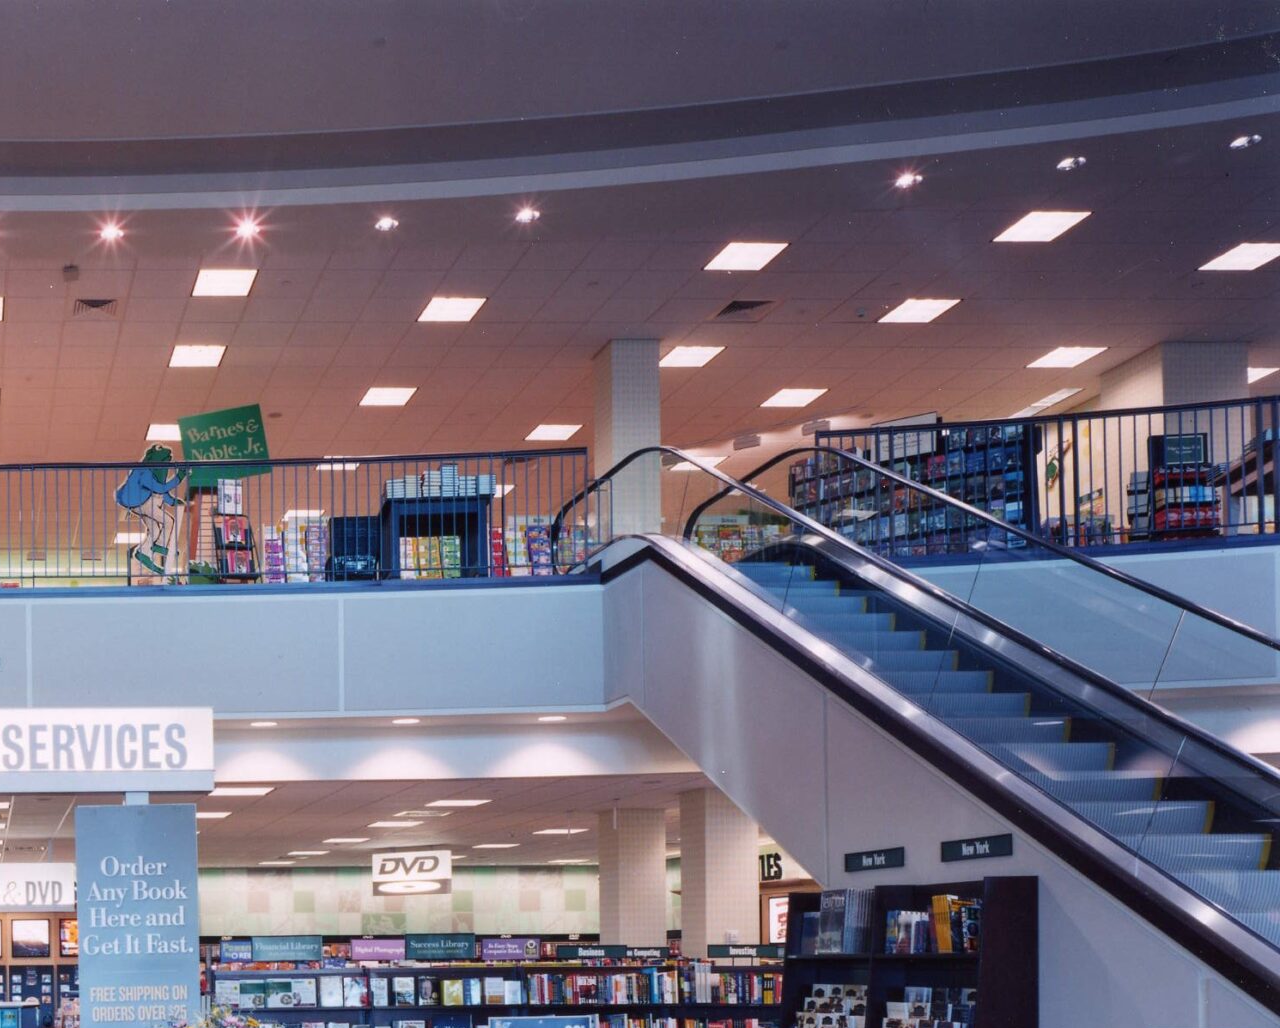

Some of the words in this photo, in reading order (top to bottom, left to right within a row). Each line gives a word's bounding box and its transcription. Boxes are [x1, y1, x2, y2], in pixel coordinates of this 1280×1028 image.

[188, 420, 244, 444] Barnes
[245, 419, 259, 433] &
[191, 445, 242, 461] Noble,
[244, 436, 264, 455] Jr.
[1, 722, 189, 771] SERVICES
[961, 843, 974, 856] New
[975, 841, 989, 854] York
[100, 855, 168, 876] Order
[378, 855, 439, 876] DVD
[862, 855, 873, 866] New
[873, 853, 886, 866] York
[2, 882, 22, 905] &
[25, 881, 63, 905] DVD
[86, 881, 128, 908] Any
[132, 879, 188, 900] Book
[89, 907, 141, 927] Here
[146, 906, 185, 926] and
[83, 935, 121, 956] Get
[124, 934, 141, 955] It
[147, 933, 194, 954] Fast.
[255, 942, 294, 952] Financial
[295, 942, 319, 953] Library
[354, 946, 371, 955] Digital
[409, 940, 440, 950] Success
[441, 939, 470, 951] Library
[578, 947, 605, 957] Business
[729, 946, 756, 957] Investing
[90, 986, 116, 1001] FREE
[118, 985, 170, 1001] SHIPPING
[172, 984, 187, 1000] ON
[92, 1006, 135, 1022] ORDERS
[137, 1005, 166, 1021] OVER
